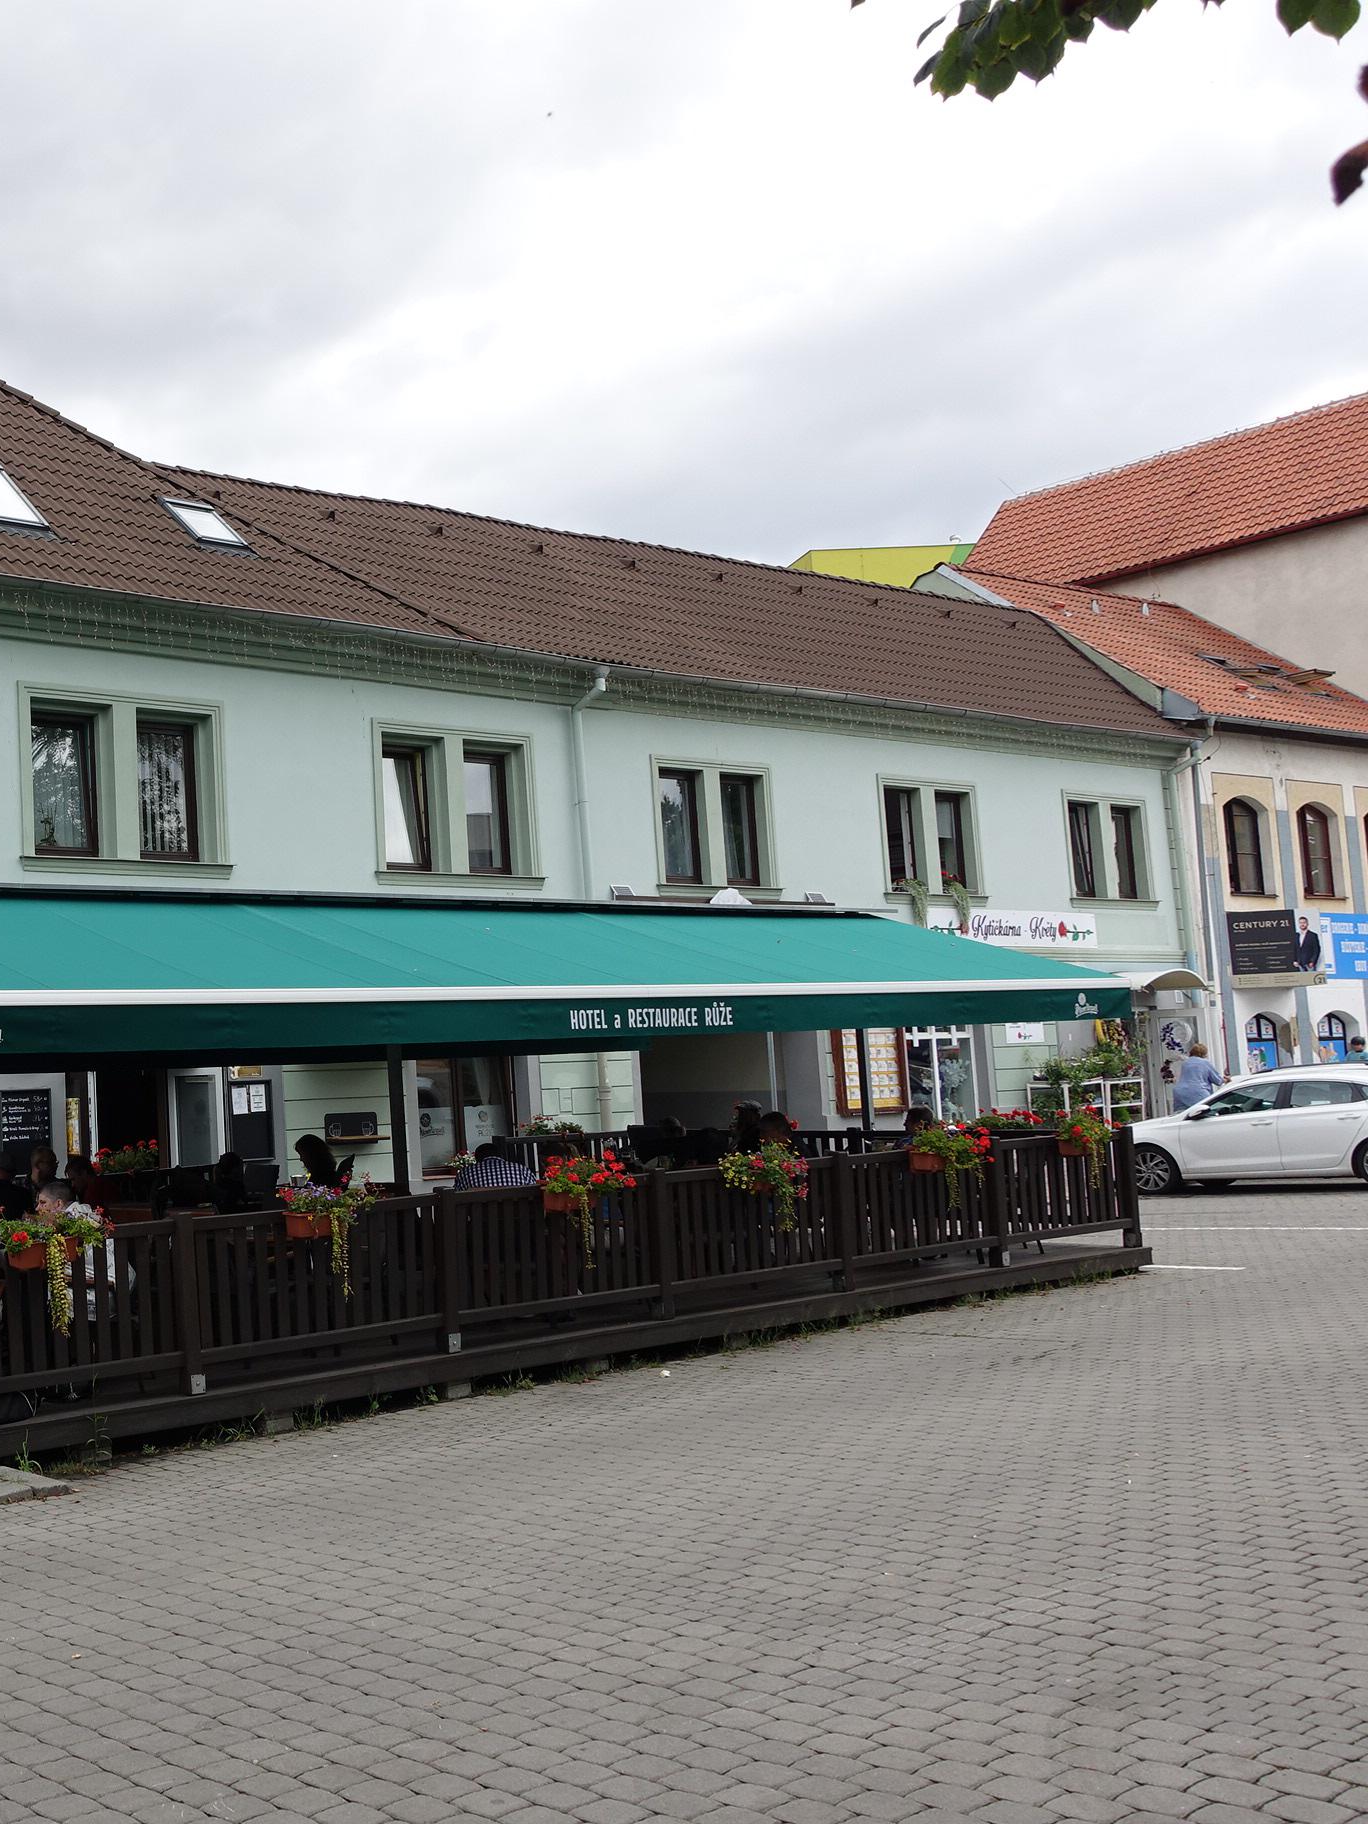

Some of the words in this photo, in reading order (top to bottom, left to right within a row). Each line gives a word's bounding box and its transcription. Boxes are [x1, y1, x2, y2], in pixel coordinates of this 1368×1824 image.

[972, 914, 1022, 941] Kytičkárna
[1232, 920, 1278, 930] CENTURY
[1280, 919, 1290, 927] 21
[569, 1009, 608, 1030] HOTEL
[614, 1013, 622, 1029] a
[627, 1007, 699, 1028] RESTAURACE
[704, 1001, 734, 1026] RŮŽE
